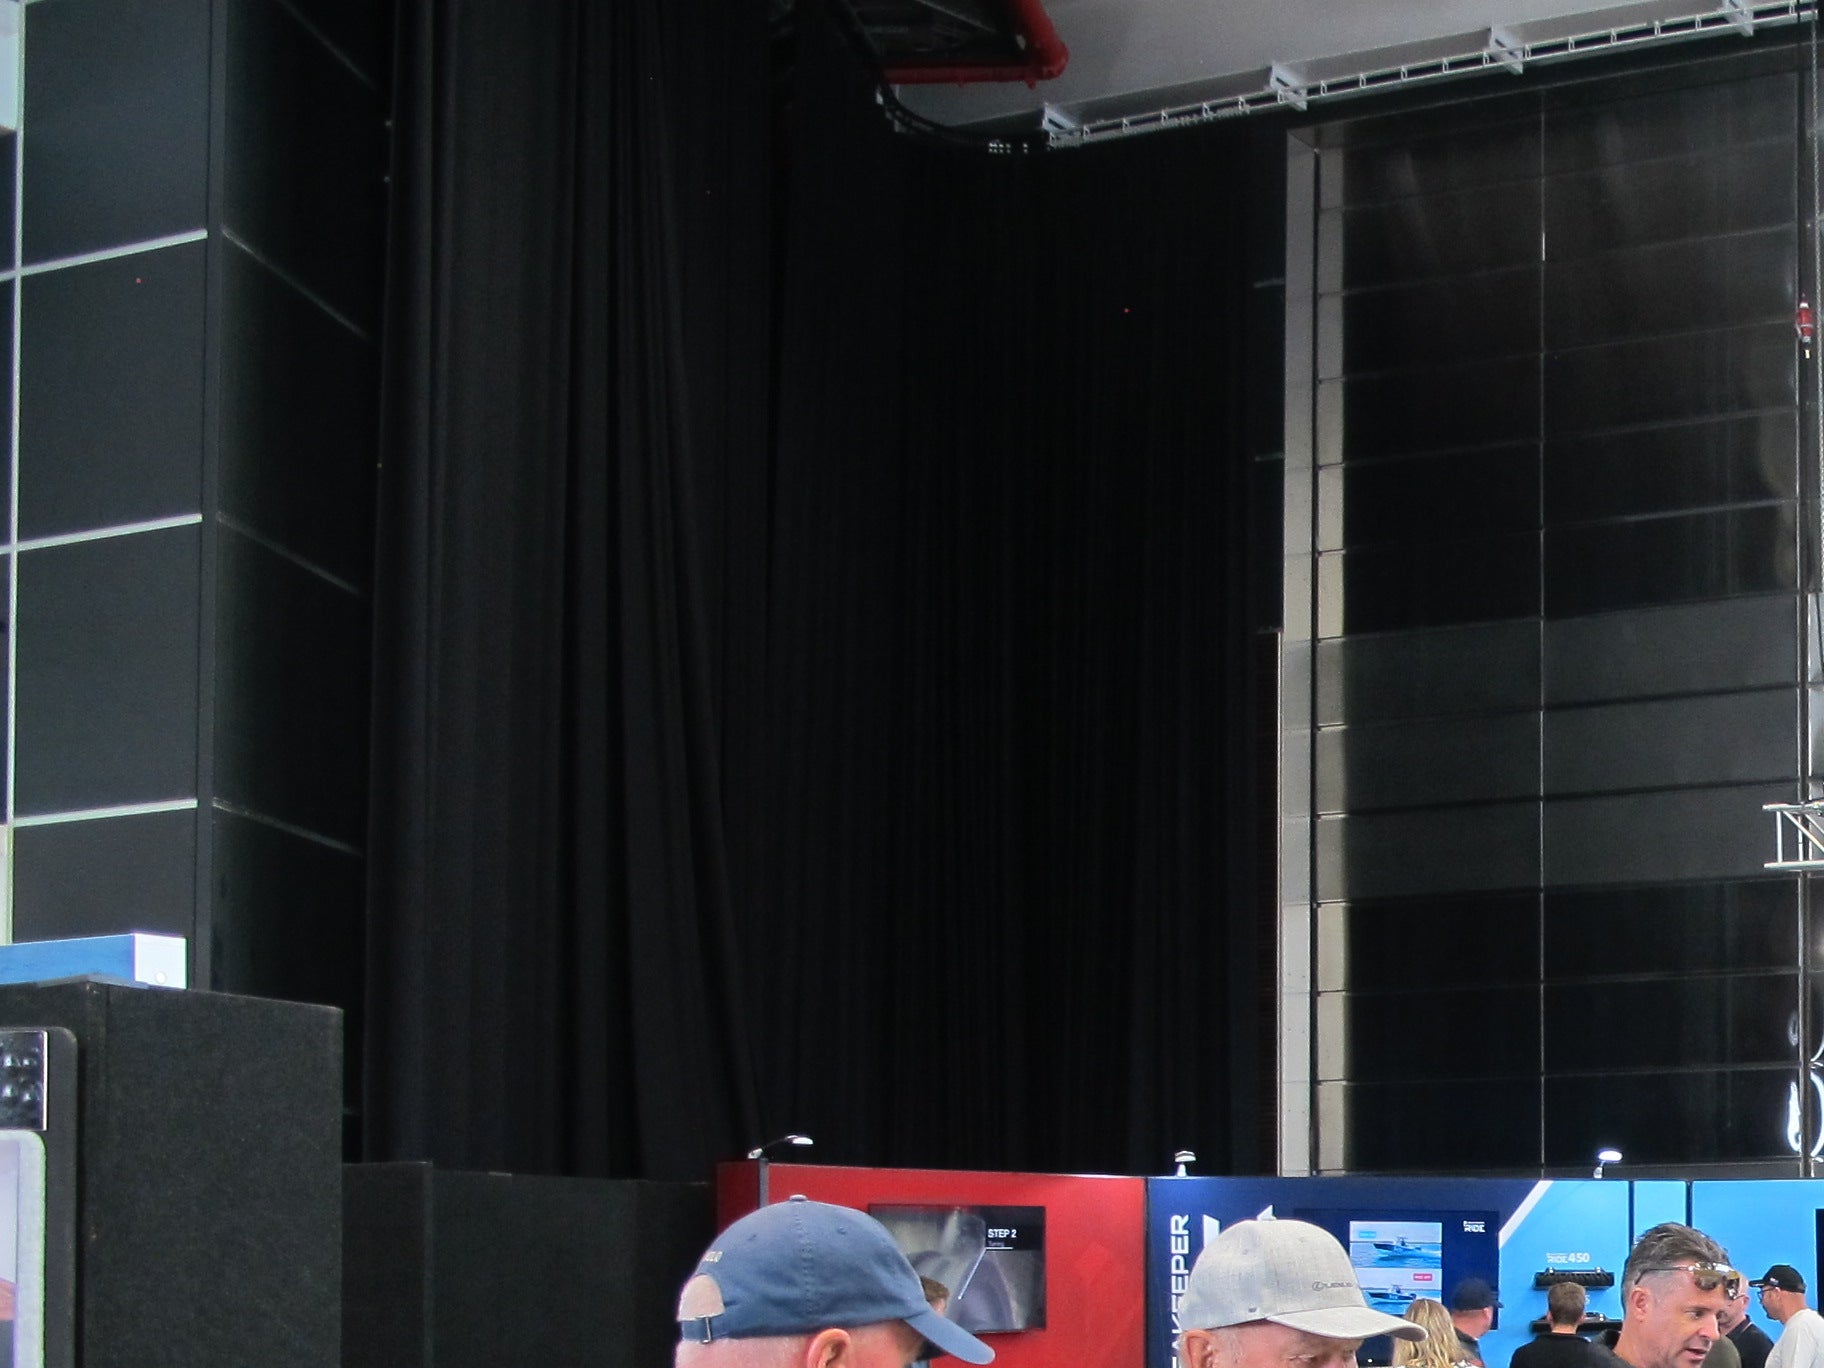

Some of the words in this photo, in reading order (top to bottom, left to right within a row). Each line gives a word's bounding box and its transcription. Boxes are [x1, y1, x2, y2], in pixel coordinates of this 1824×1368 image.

[987, 1228, 1010, 1238] STEP
[1011, 1229, 1017, 1238] 2
[1568, 1252, 1590, 1263] 450
